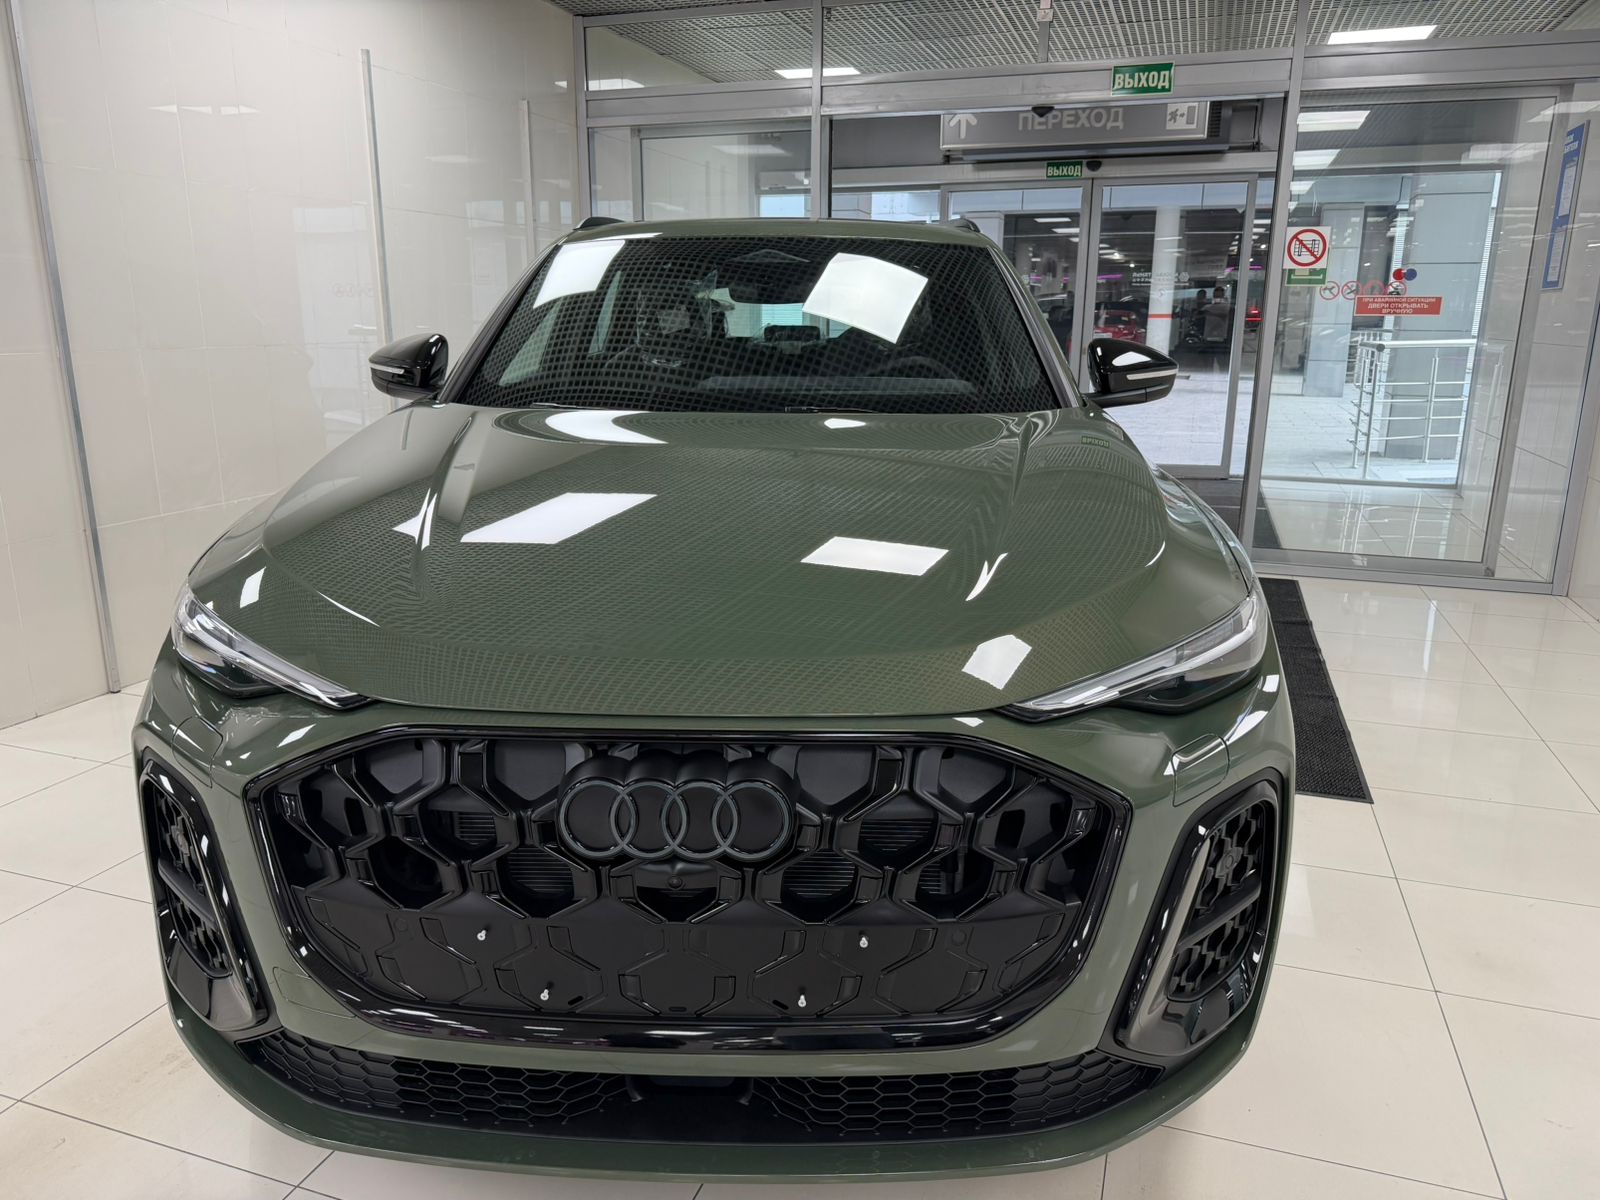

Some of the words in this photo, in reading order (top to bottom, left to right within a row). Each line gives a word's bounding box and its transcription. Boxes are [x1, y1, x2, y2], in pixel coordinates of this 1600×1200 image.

[1114, 70, 1170, 90] ВЫХОД
[1018, 108, 1124, 131] ПЕРЕХОД
[1047, 164, 1081, 177] ВЫХОД
